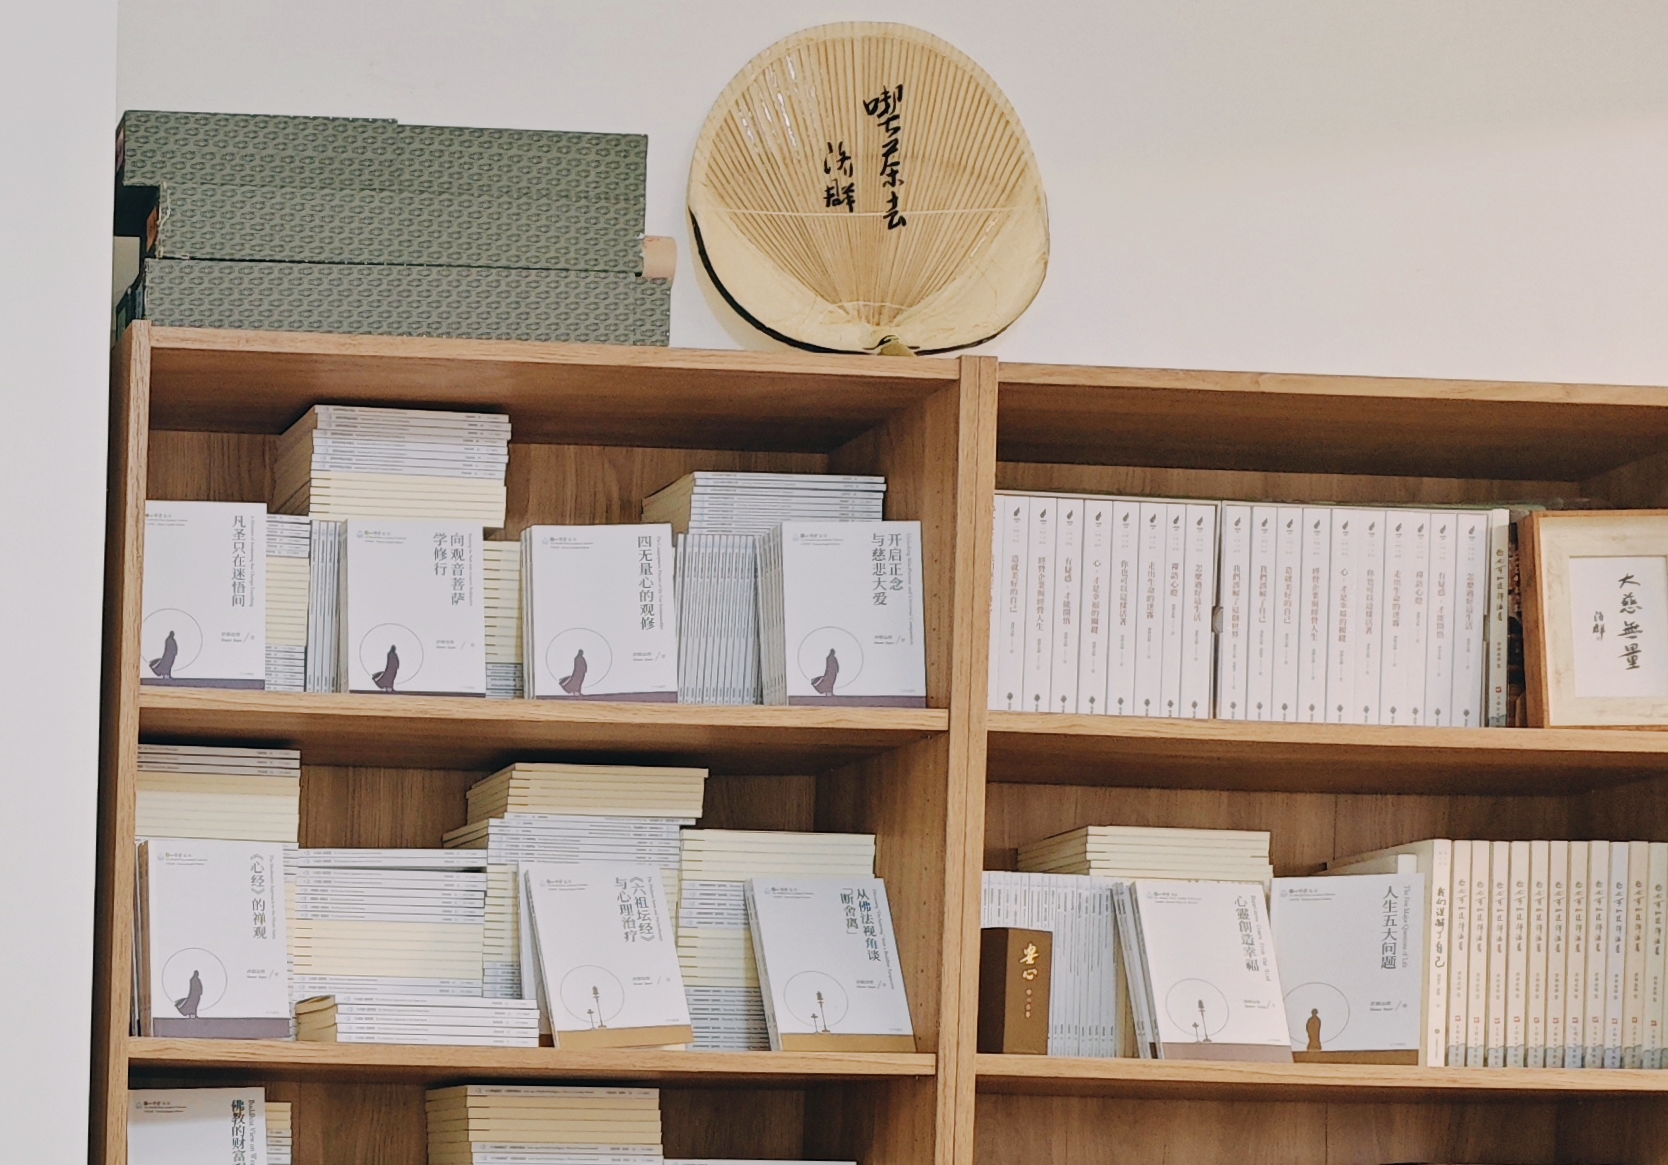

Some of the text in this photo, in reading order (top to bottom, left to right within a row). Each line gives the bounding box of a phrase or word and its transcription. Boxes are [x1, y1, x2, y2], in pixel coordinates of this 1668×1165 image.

[231, 515, 246, 608] 凡圣只在迷悟间
[433, 532, 447, 576] 学修行
[450, 532, 465, 606] 向观音菩萨
[638, 535, 655, 630] 四无量心的观修
[871, 533, 887, 605] 与慈悲大爱
[888, 533, 904, 591] 开启正念
[250, 854, 267, 940] 《心经》的禅观
[615, 877, 637, 942] 与心理治疗
[629, 876, 655, 941] 《六祖坛经》
[857, 888, 881, 961] 从佛法视角谈
[1381, 885, 1399, 970] 人生五大问题
